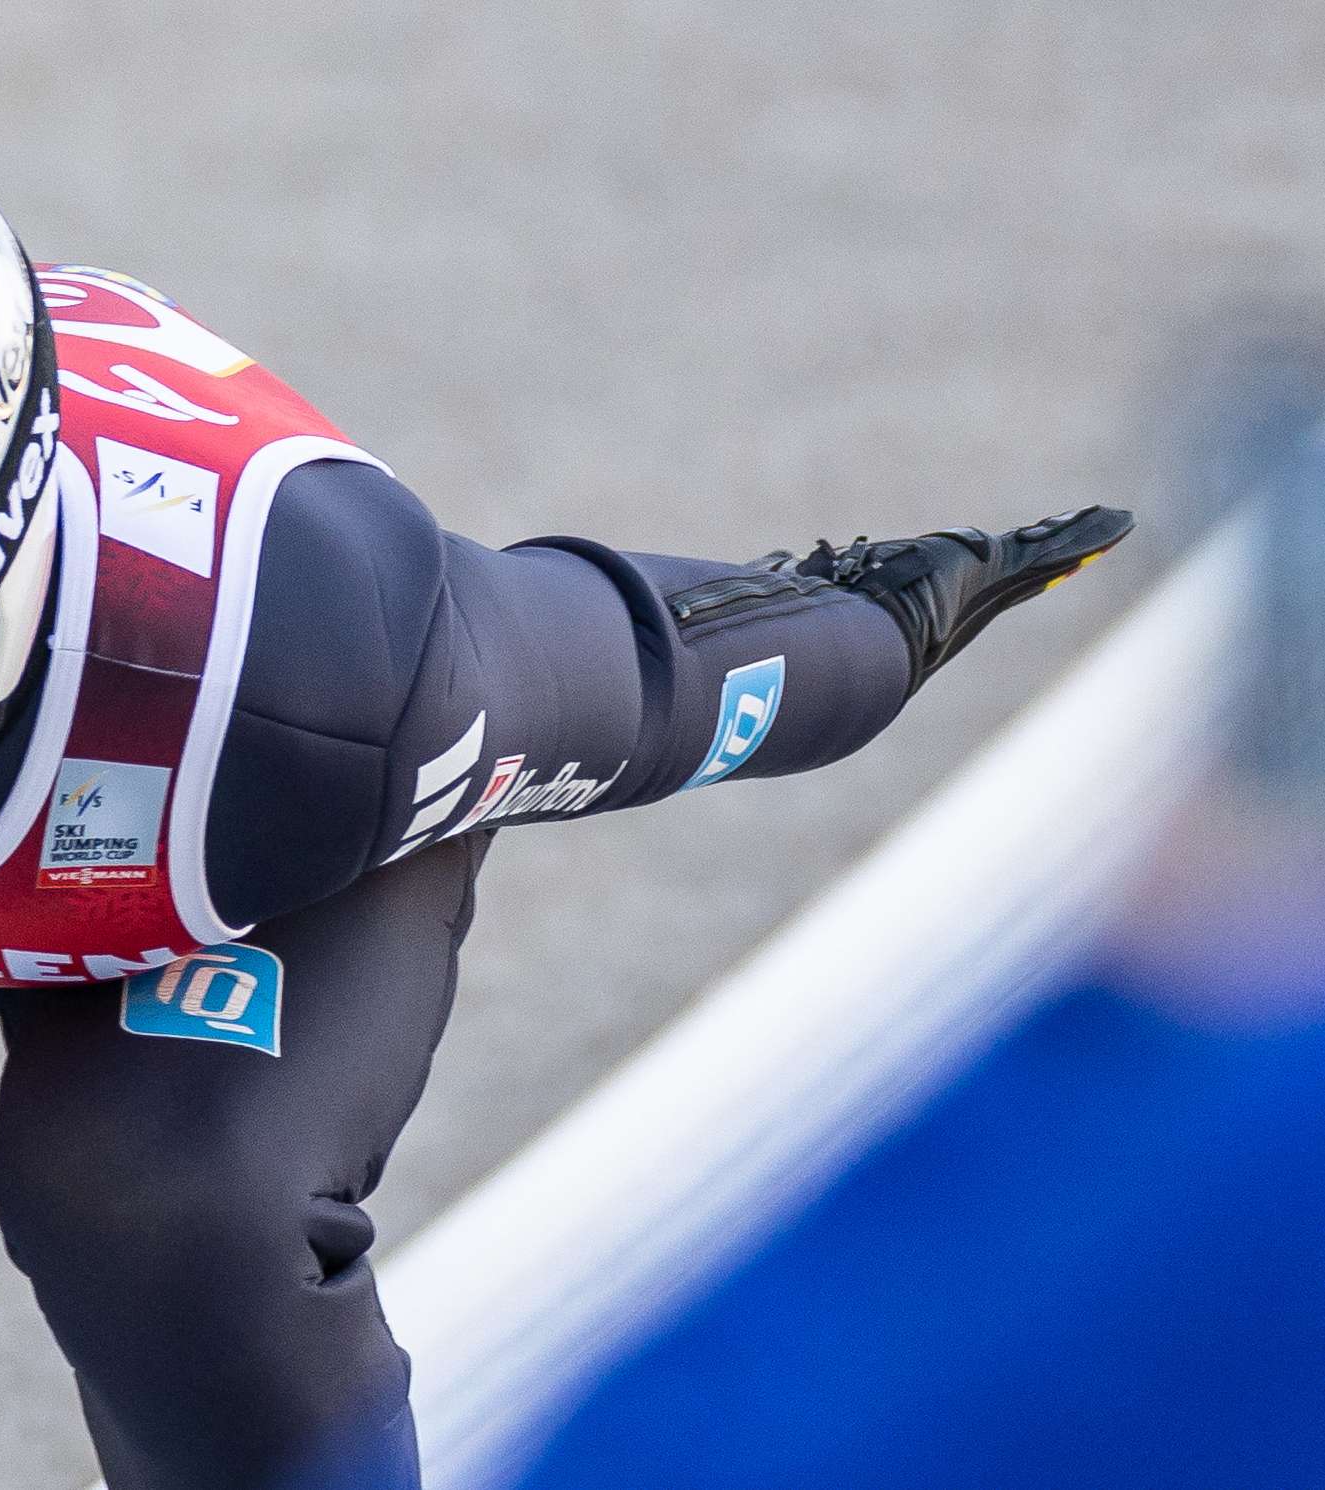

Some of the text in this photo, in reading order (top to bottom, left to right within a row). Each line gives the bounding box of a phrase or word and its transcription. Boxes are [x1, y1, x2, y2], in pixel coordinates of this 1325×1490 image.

[54, 824, 86, 838] SKI
[51, 838, 139, 851] JUMPING
[51, 850, 135, 862] WORLD CUP
